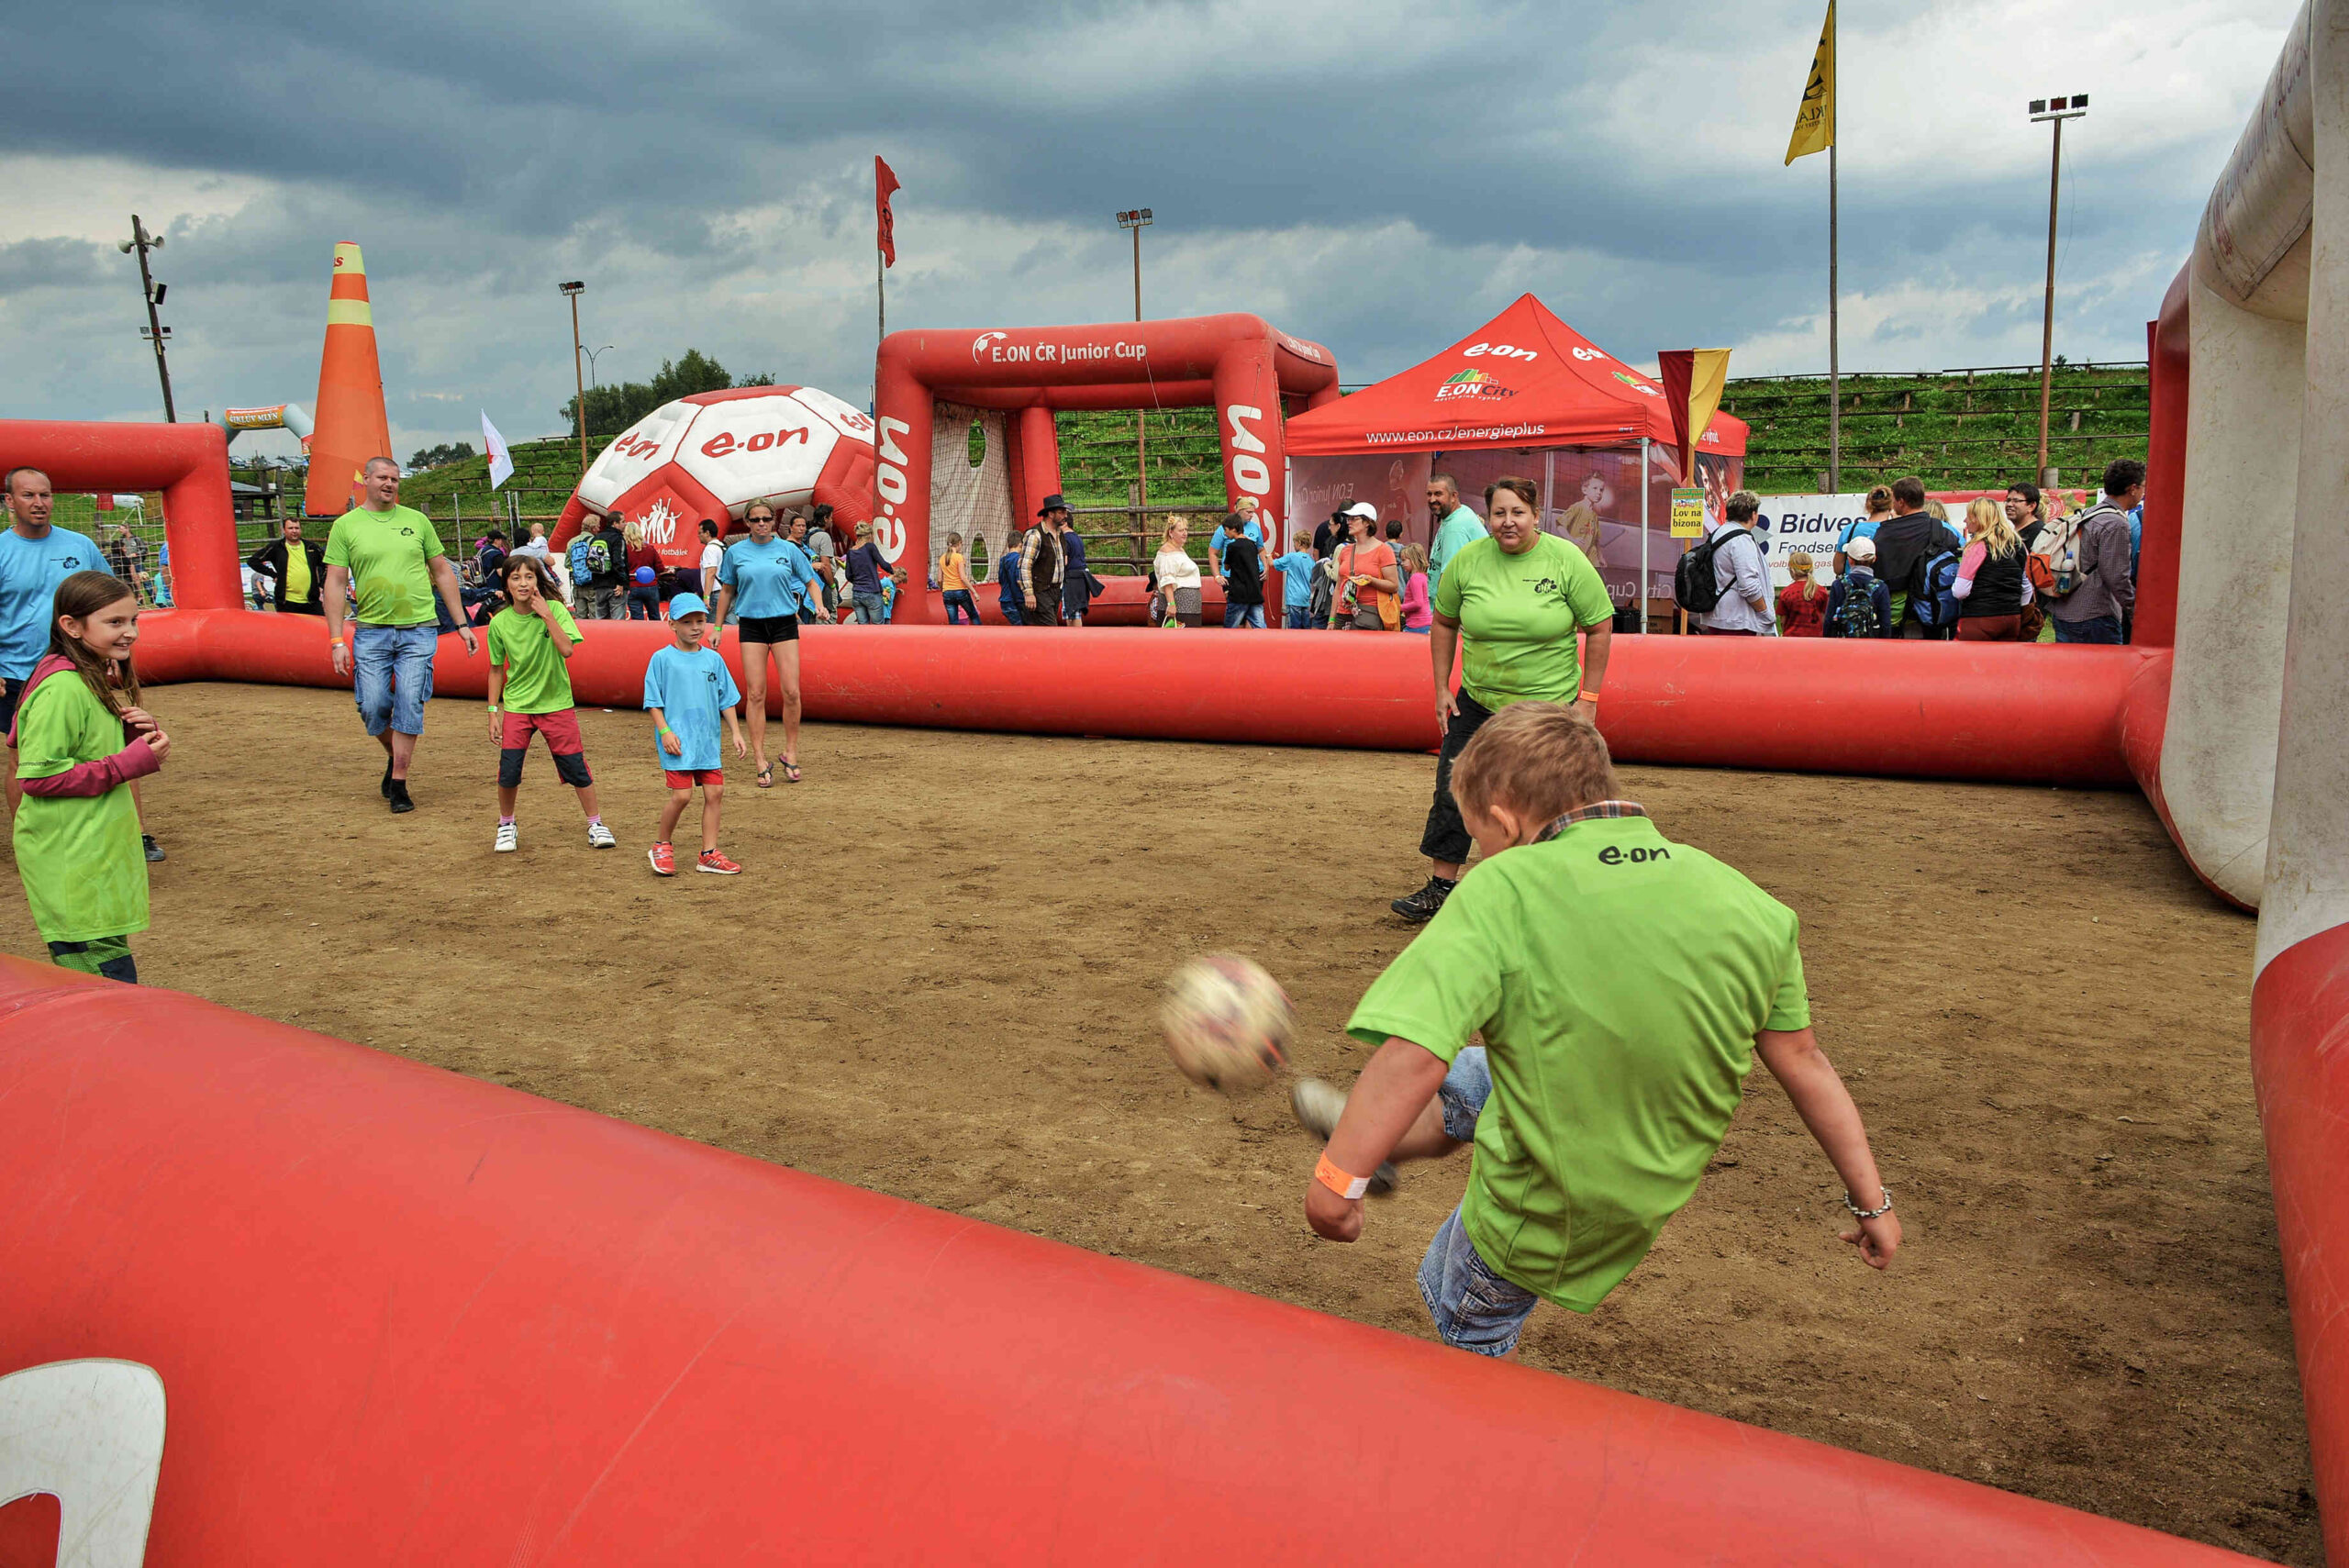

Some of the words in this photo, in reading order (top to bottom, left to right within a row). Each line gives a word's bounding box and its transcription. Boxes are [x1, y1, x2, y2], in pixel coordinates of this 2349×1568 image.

[993, 346, 1030, 362] E.ON
[1035, 341, 1056, 361] ČR
[1061, 342, 1110, 364] Junior
[1115, 341, 1147, 361] Cup
[1365, 422, 1545, 444] www.eon.cz/energieplus
[1673, 508, 1688, 517] Lov
[1673, 518, 1701, 528] bizona
